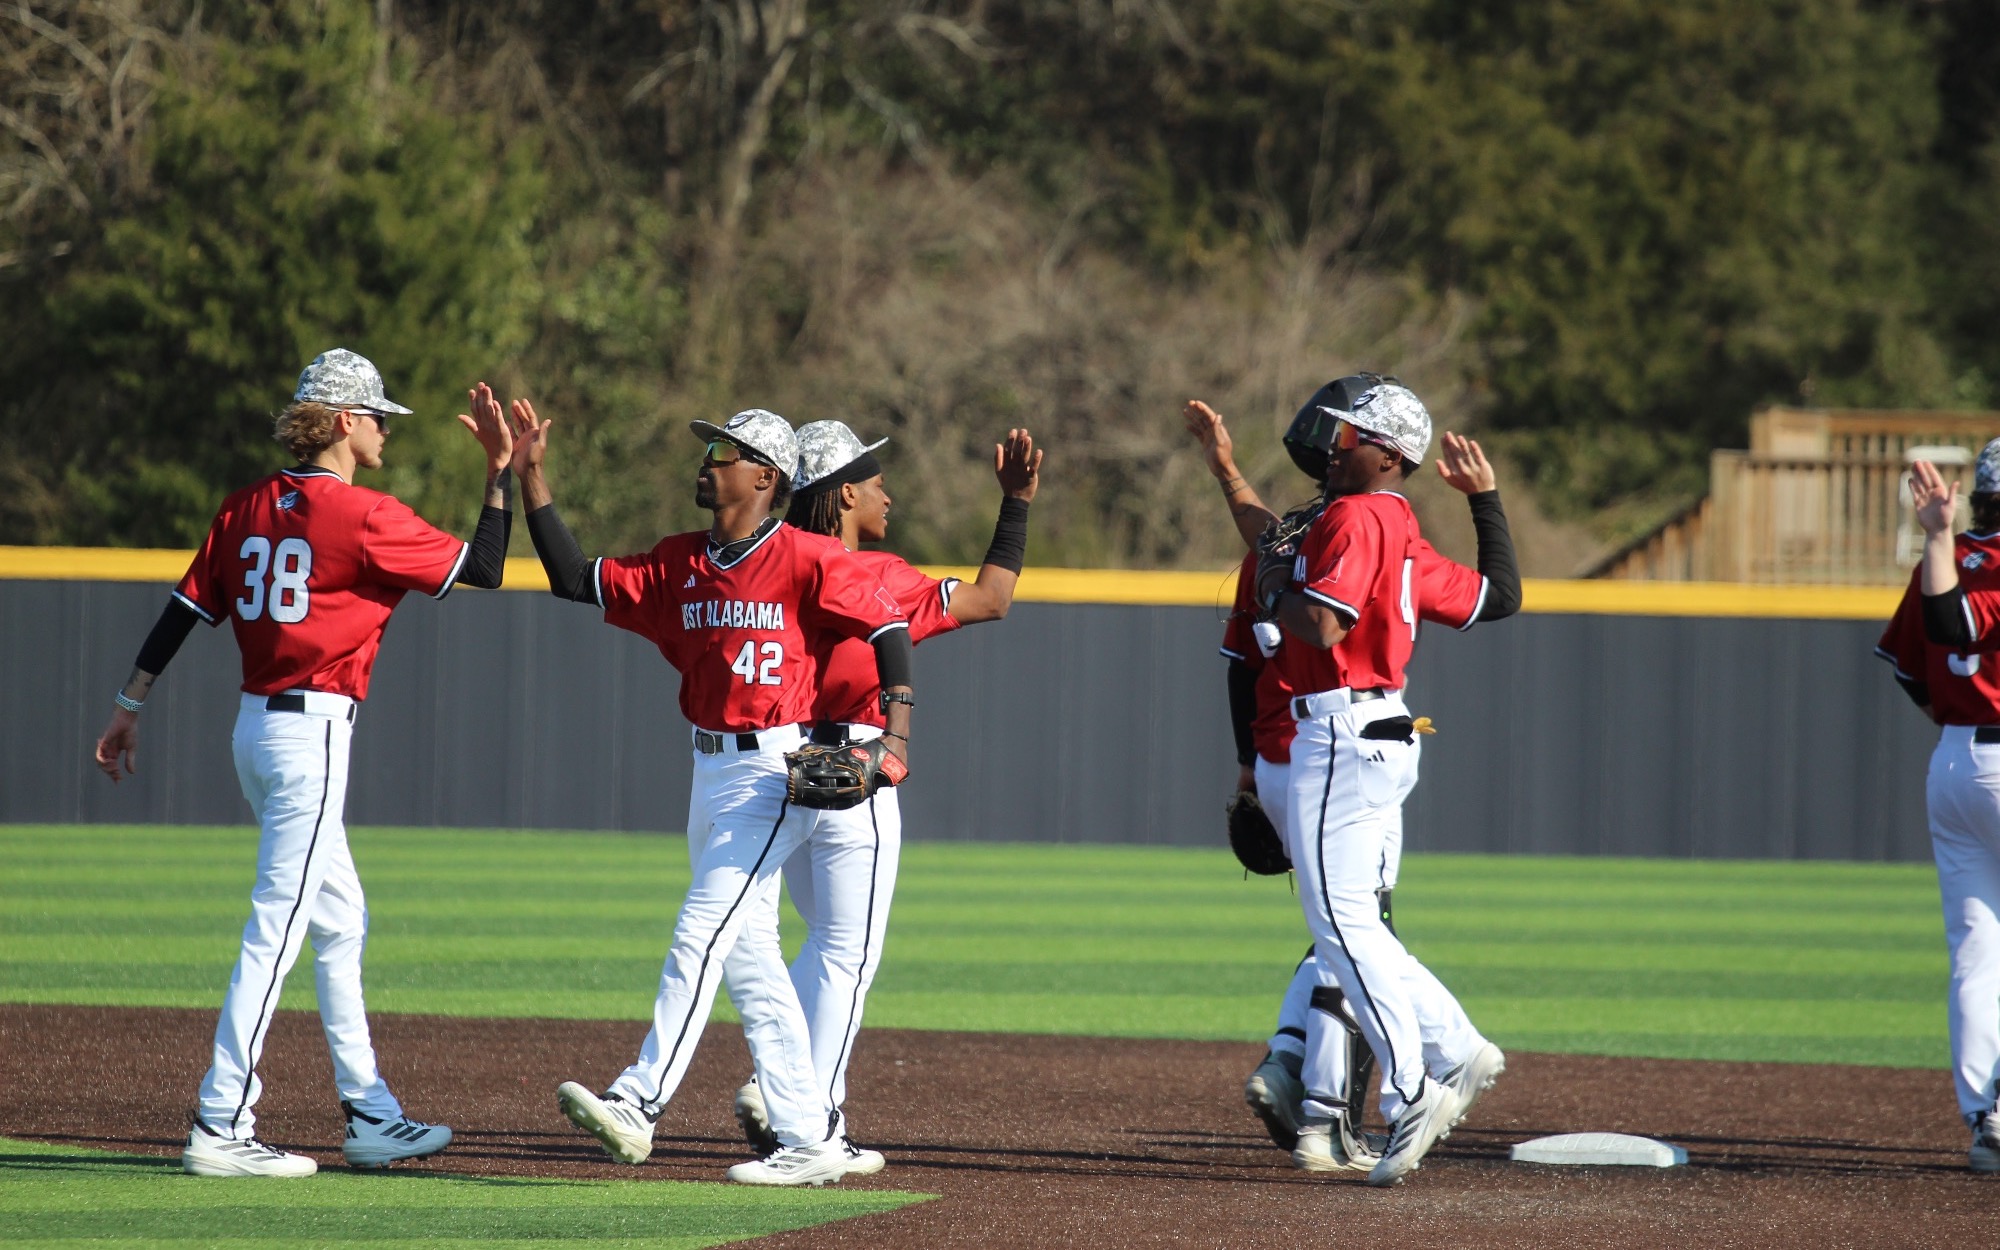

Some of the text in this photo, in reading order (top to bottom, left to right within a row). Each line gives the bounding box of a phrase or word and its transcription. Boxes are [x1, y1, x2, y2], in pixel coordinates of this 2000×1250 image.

[236, 536, 312, 623] 38
[705, 600, 784, 630] ALABAMA
[731, 640, 783, 685] 42
